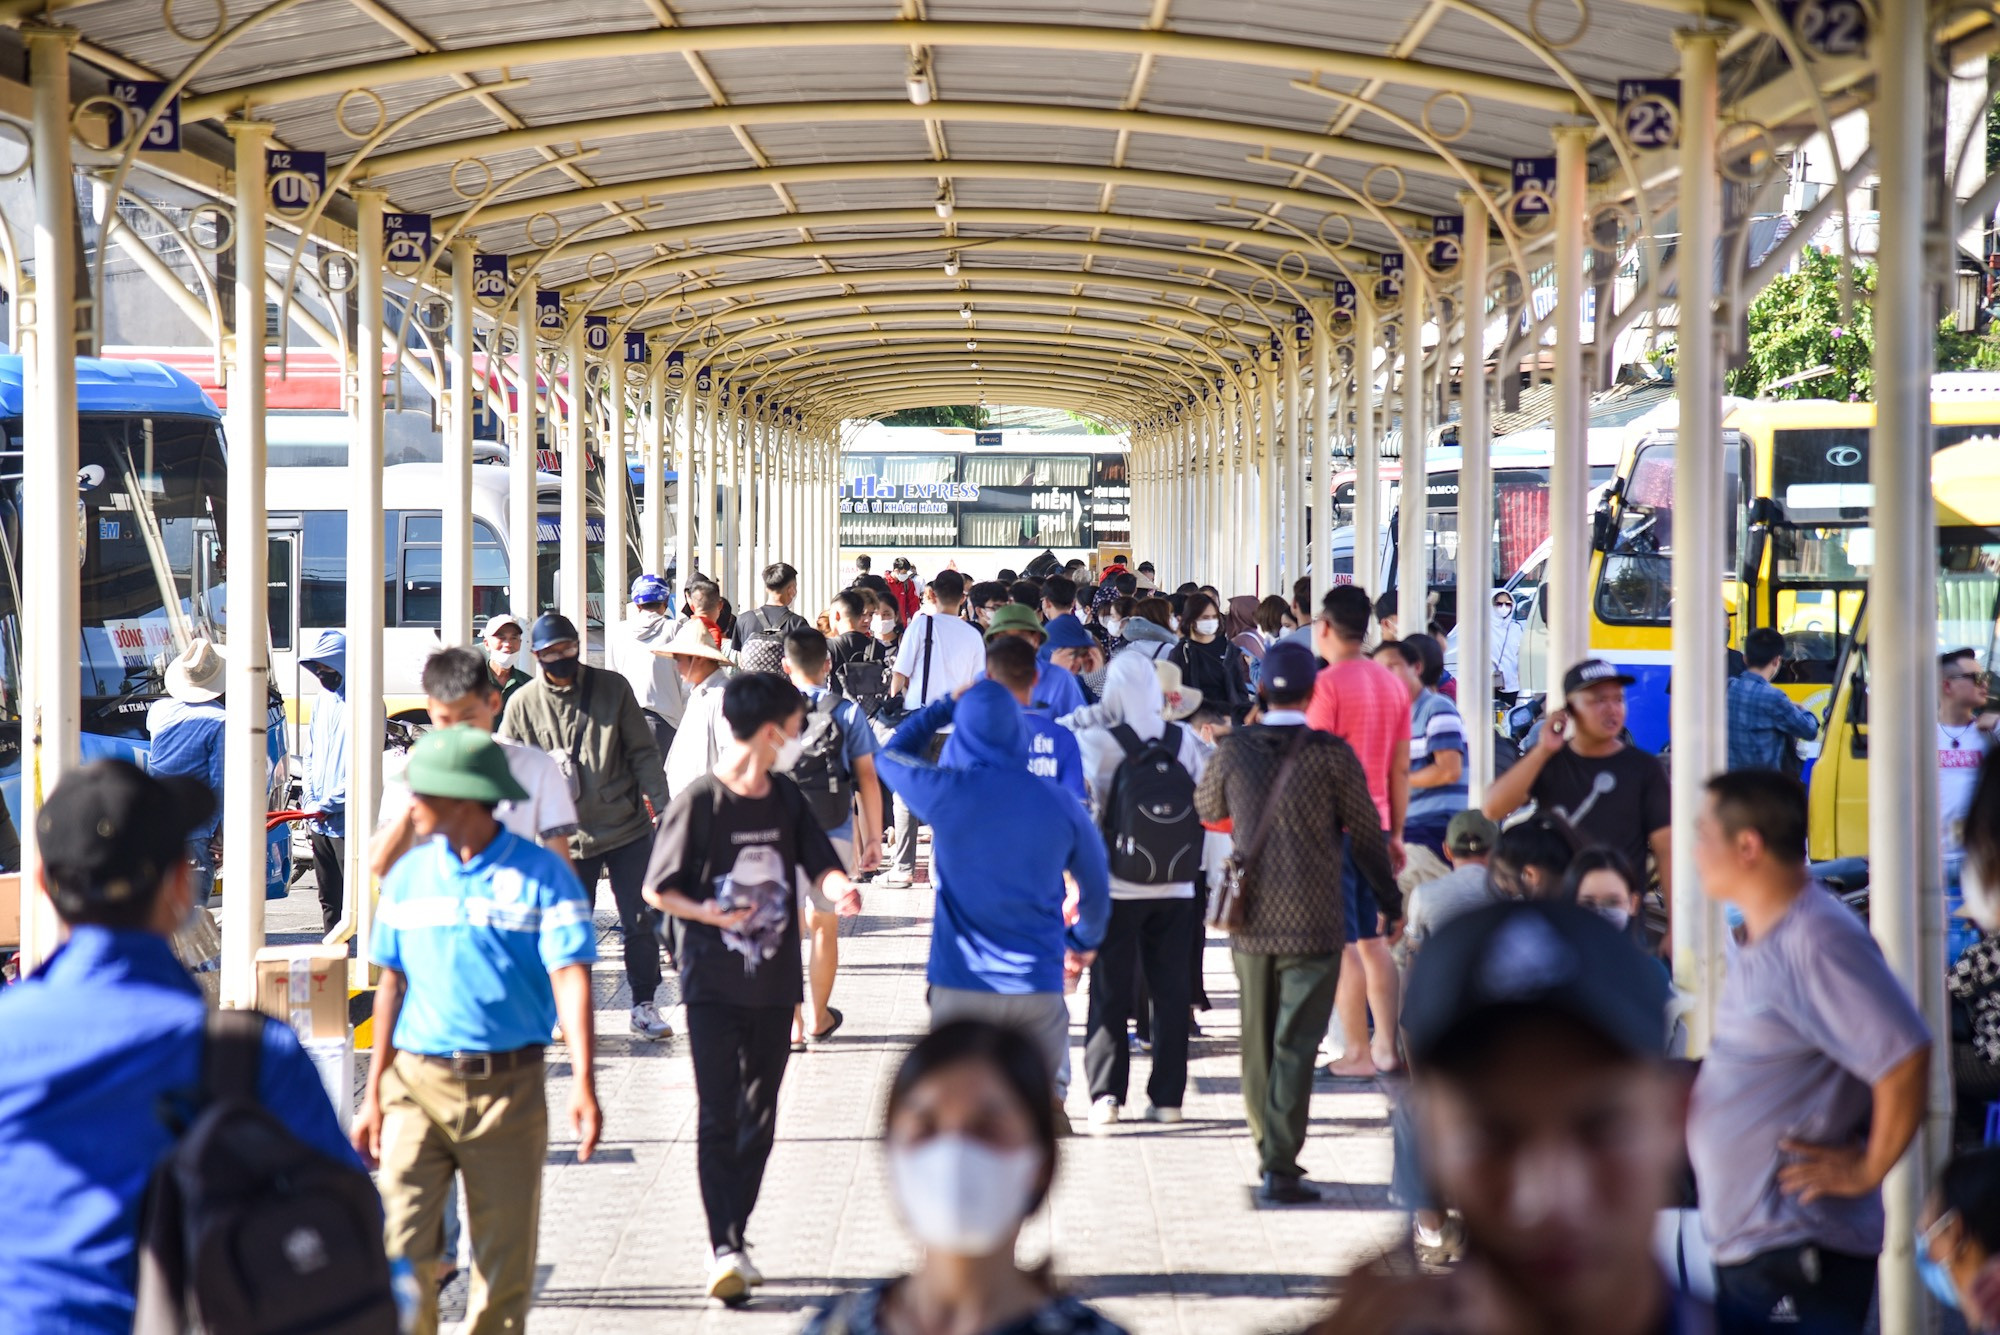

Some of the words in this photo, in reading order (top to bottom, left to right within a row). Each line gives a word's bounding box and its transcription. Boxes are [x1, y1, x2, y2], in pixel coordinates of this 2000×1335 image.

[113, 85, 137, 102] A2
[271, 154, 292, 169] A2
[1515, 162, 1534, 176] A1
[386, 216, 403, 229] A2
[1437, 219, 1452, 231] A1
[391, 231, 427, 257] 07
[1341, 295, 1355, 315] 2
[592, 328, 605, 346] 0
[904, 483, 980, 500] EXPRESS
[1031, 487, 1071, 510] MIỄN
[1425, 485, 1459, 495] SAMCO
[855, 499, 868, 513] CẢ
[871, 500, 882, 513] VÌ
[884, 500, 917, 513] KHÁCH
[919, 501, 948, 513] HÀNG
[1038, 512, 1066, 532] PHÍ
[112, 622, 146, 648] ĐỒNG
